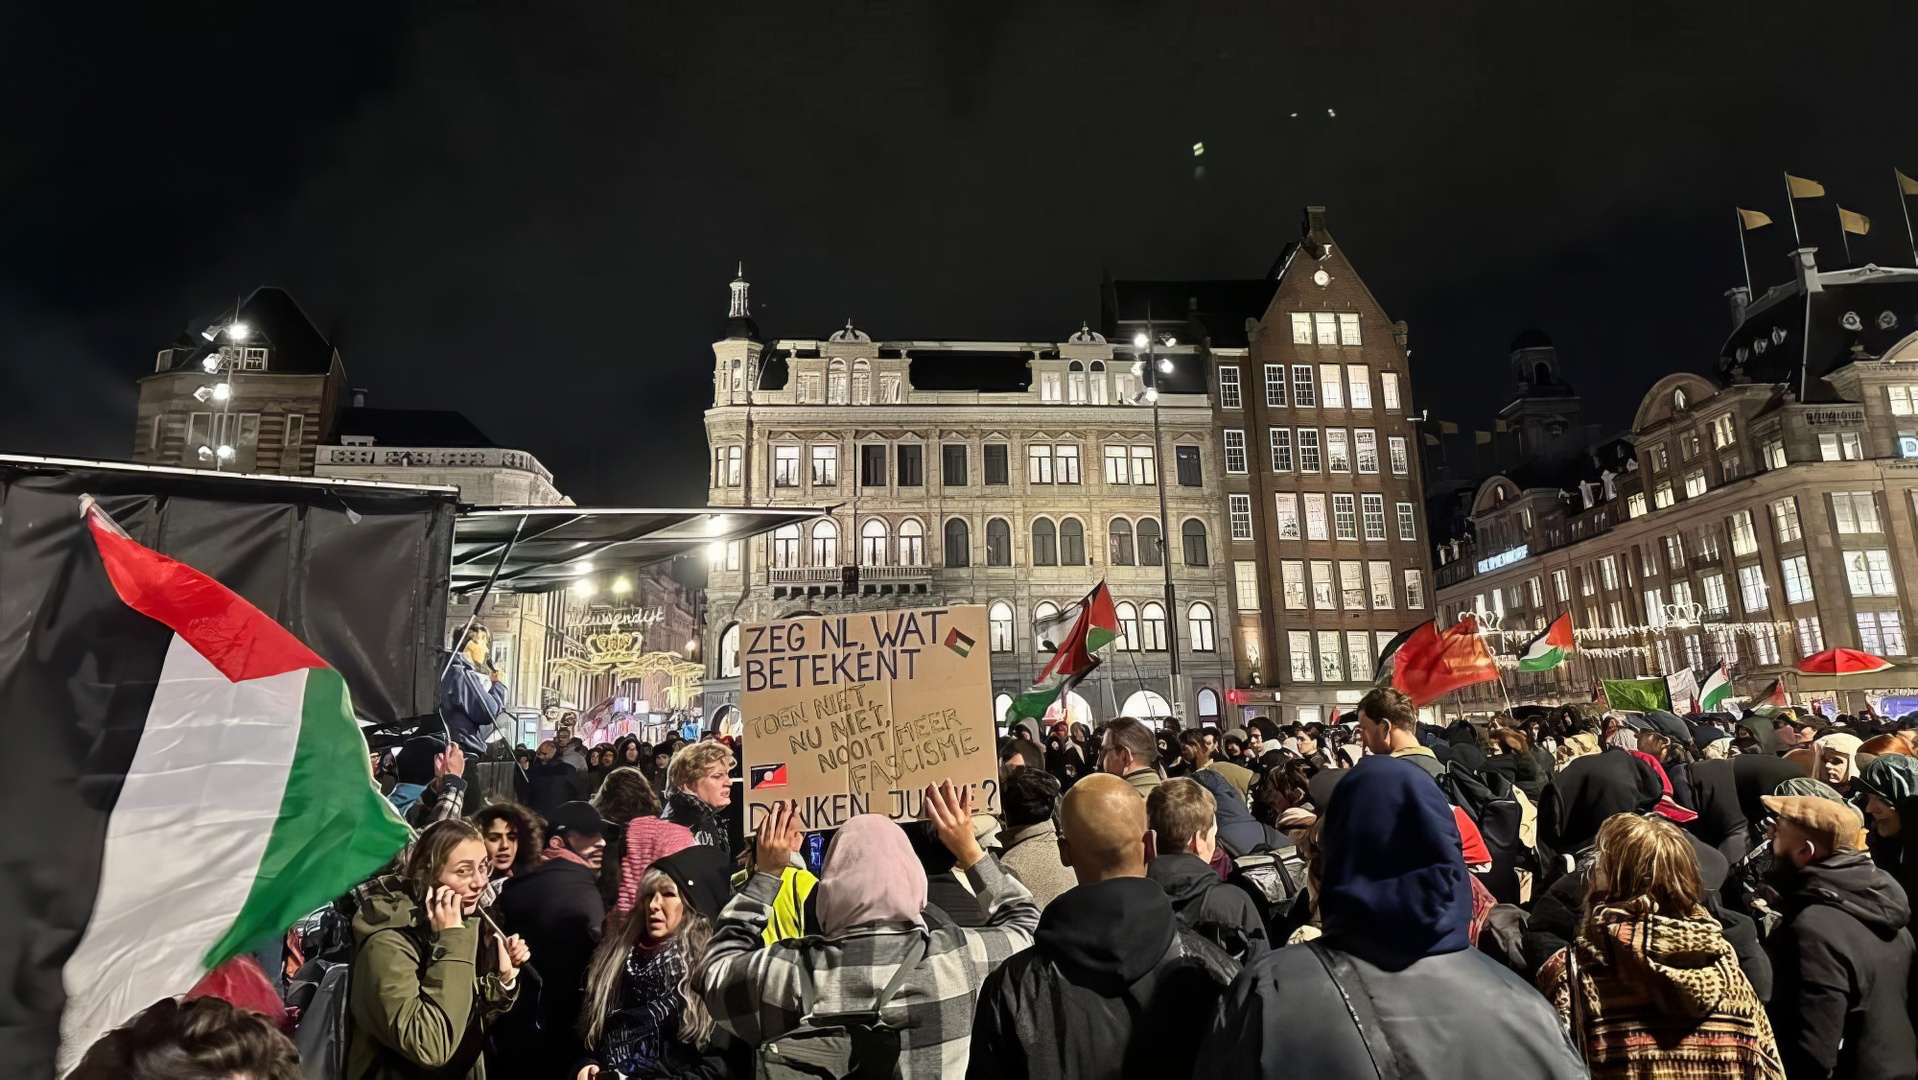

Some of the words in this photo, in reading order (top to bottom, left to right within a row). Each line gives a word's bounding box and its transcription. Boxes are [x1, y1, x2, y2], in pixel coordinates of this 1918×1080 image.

[746, 623, 805, 654] ZEG
[821, 617, 864, 651] NL,
[871, 610, 948, 648] WAT
[746, 649, 921, 692] BETEKENT
[747, 702, 808, 738] TOEN
[814, 684, 875, 719] NIET,
[788, 726, 822, 754] NU
[830, 704, 891, 741] NIET,
[818, 732, 886, 773] NOOIT
[895, 709, 962, 745] MEER
[850, 728, 979, 795] FASCISME
[750, 792, 869, 832] DNKEN
